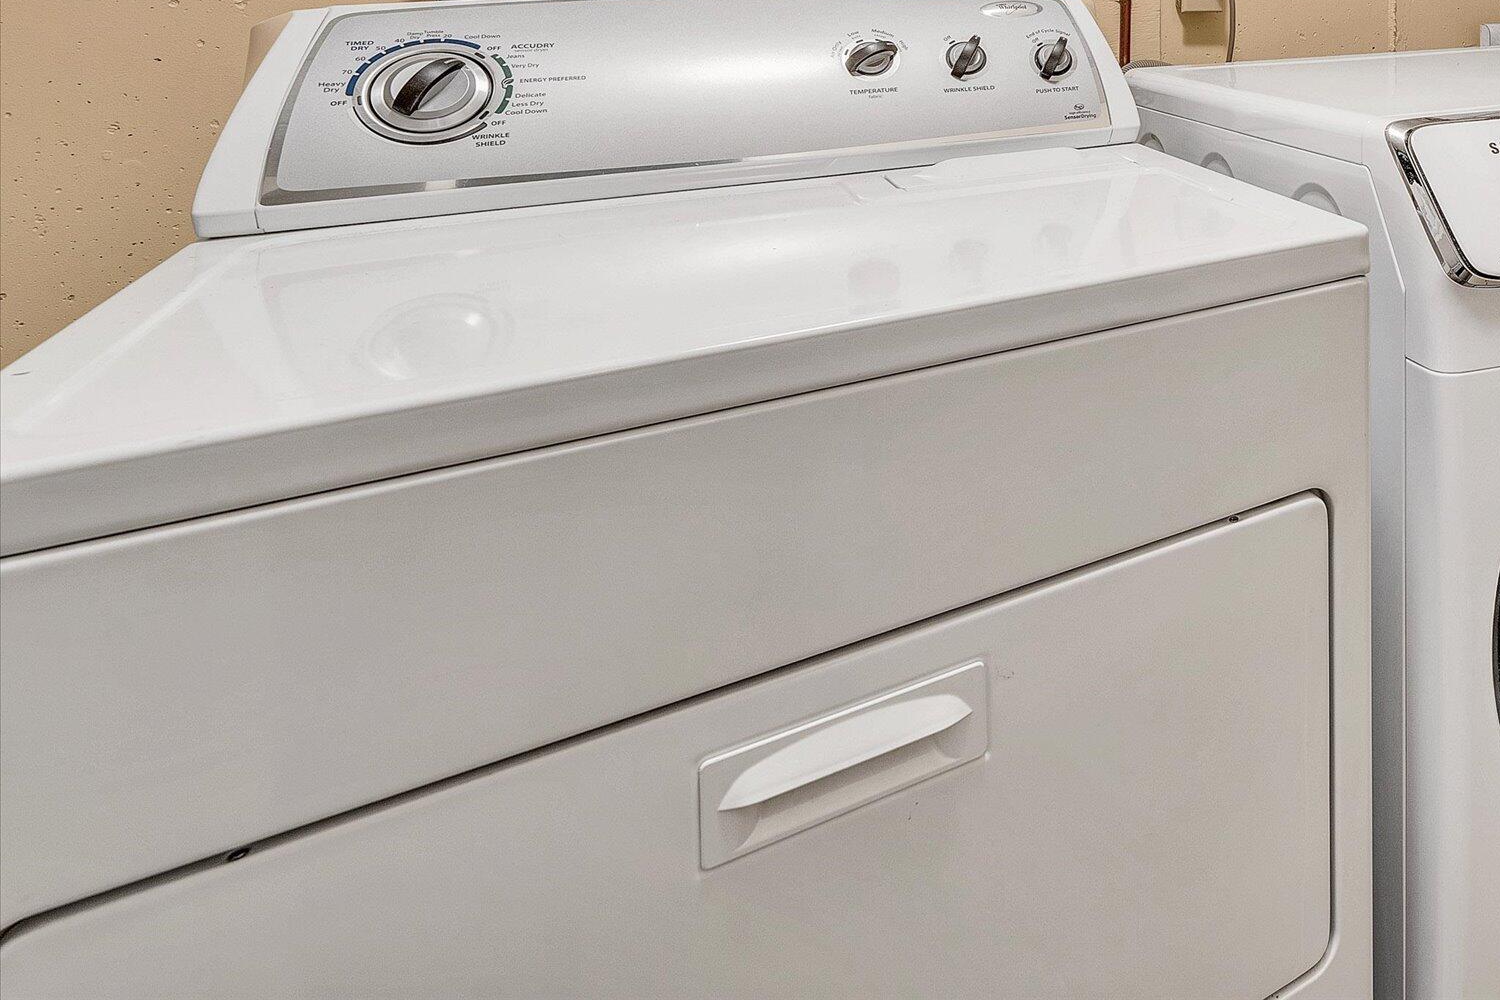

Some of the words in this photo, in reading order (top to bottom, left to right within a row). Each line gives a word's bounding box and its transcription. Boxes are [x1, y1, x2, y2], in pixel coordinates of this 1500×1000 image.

[318, 81, 347, 89] Heavy
[849, 87, 898, 95] TEMPERATURE
[943, 86, 973, 94] WRINKLE
[528, 100, 545, 108] Dry
[472, 132, 510, 140] WRINKLE
